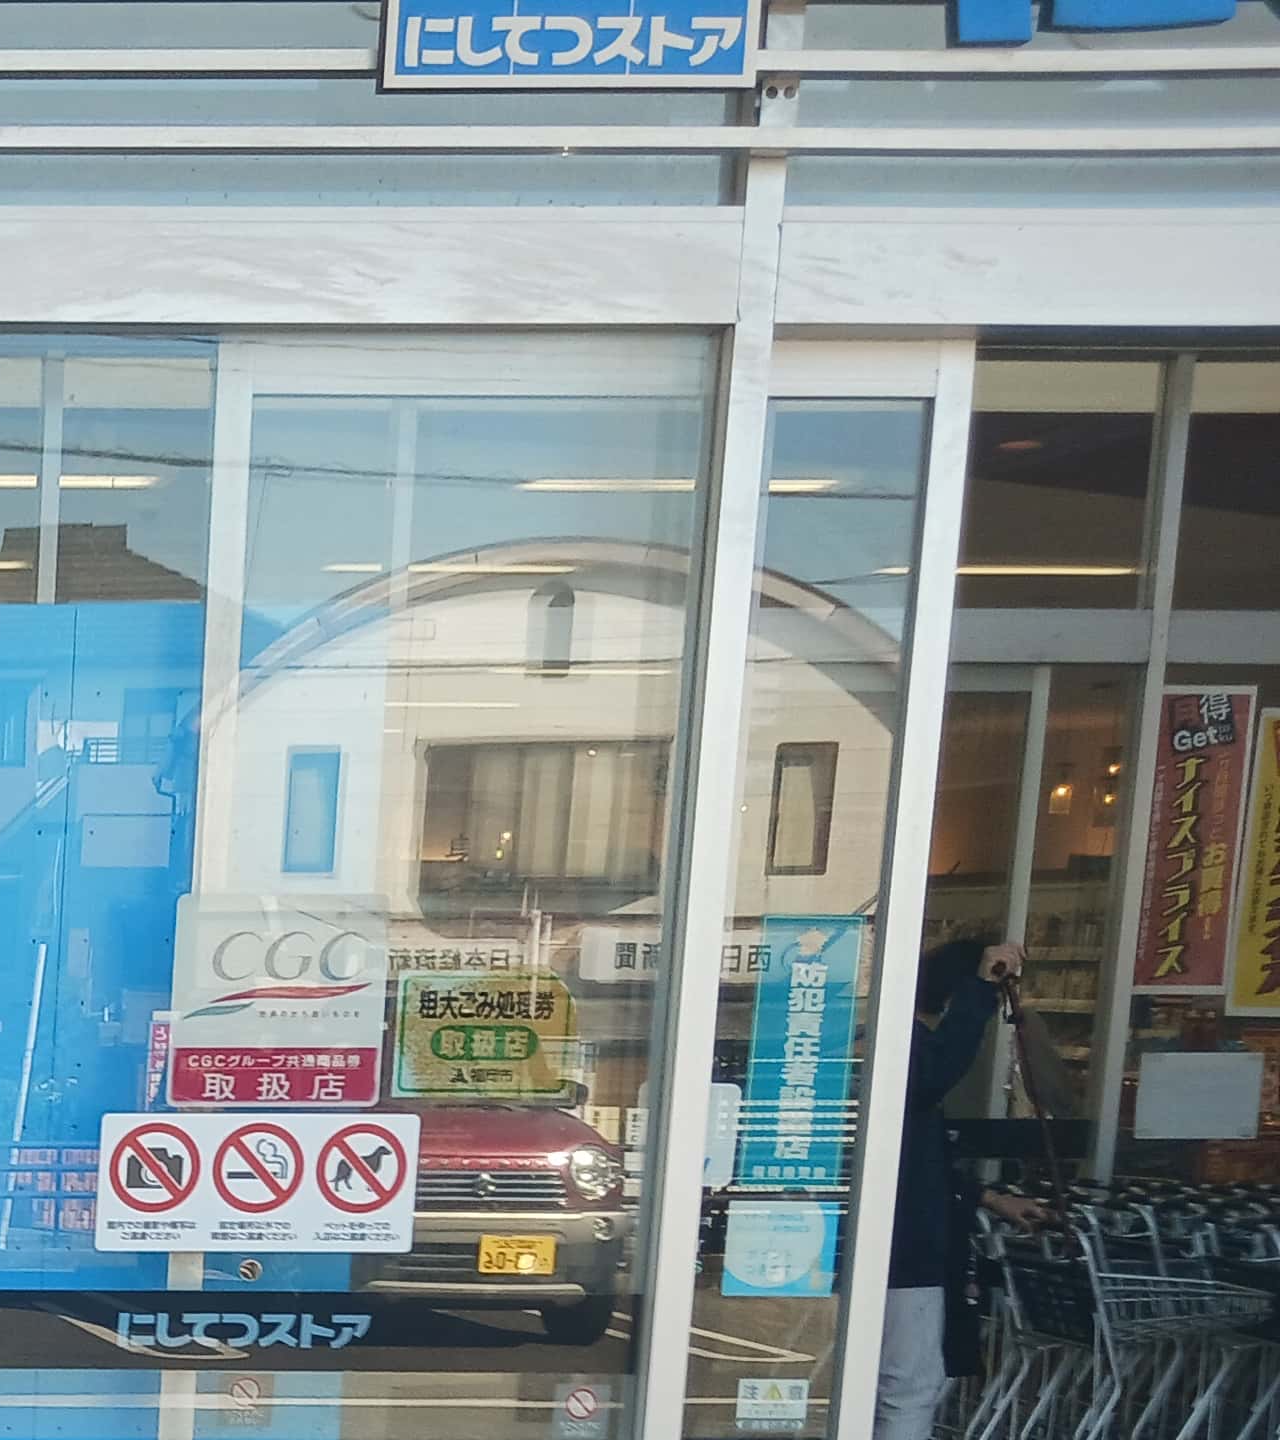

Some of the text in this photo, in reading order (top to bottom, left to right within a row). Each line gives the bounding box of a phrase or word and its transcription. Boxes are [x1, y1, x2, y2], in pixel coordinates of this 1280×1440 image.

[404, 14, 740, 69] にしてつストア
[1173, 725, 1219, 751] Get
[1153, 756, 1208, 977] ナイスプライス
[211, 930, 371, 982] CGC
[201, 1071, 347, 1101] 取扱店
[116, 1311, 372, 1349] にしてつストア
